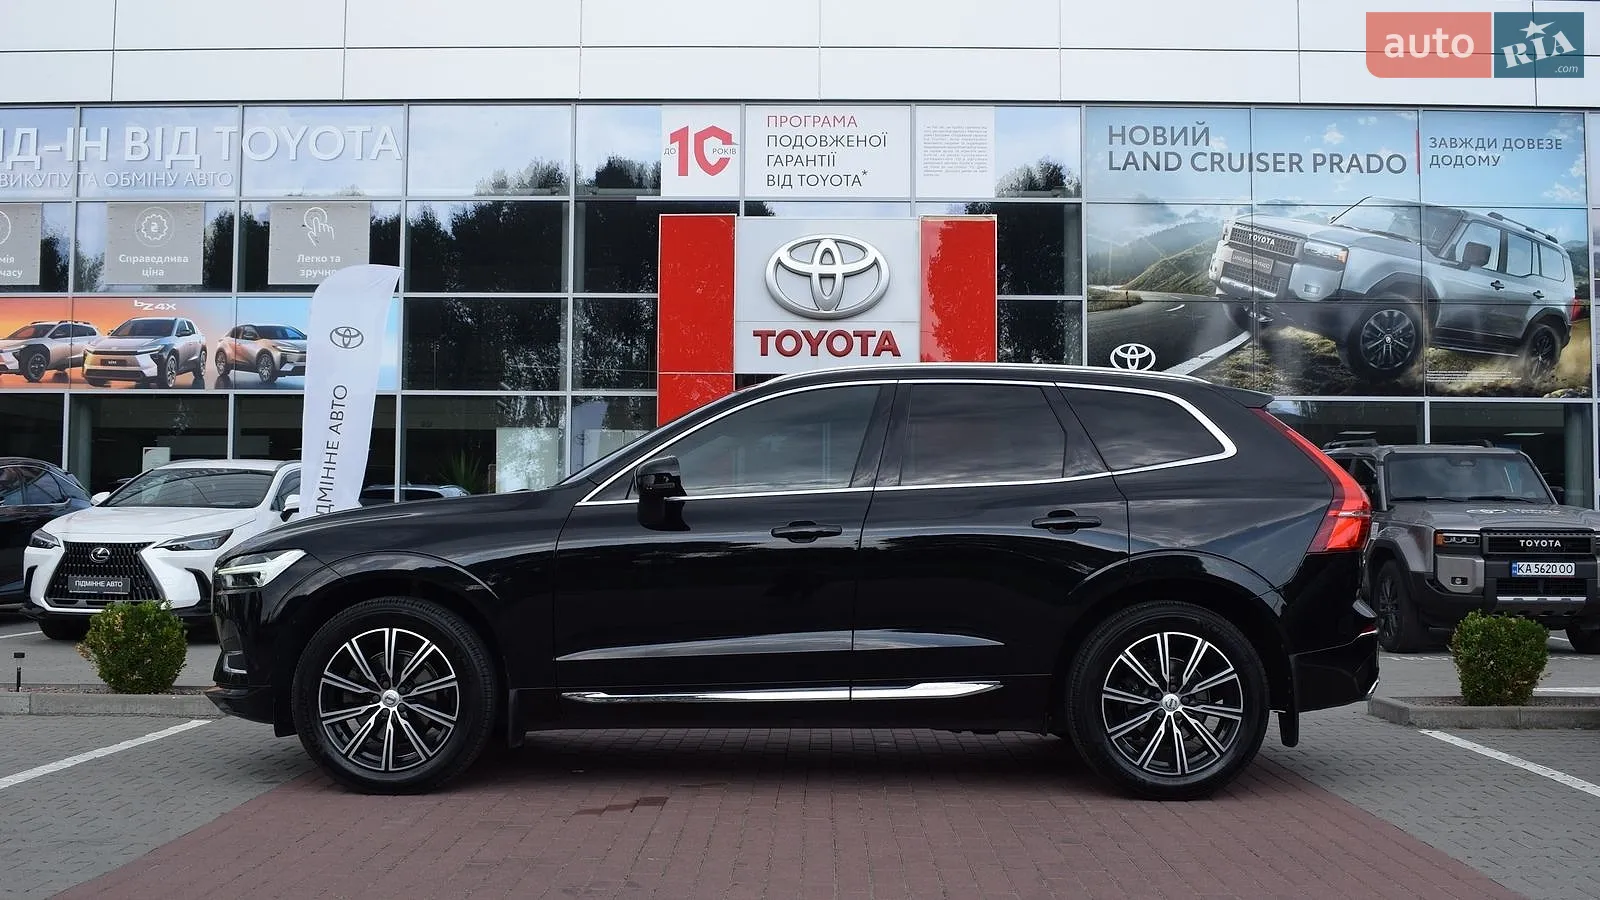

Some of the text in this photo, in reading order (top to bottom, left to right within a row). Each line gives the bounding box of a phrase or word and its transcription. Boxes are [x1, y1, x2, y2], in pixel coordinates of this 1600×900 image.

[767, 115, 858, 128] ПРОГРАМА
[767, 131, 888, 150] ПОДОВЖЕНОЇ
[1108, 121, 1210, 147] НОВИЙ
[0, 126, 403, 170] Д-ІН ВІД TOYOTA
[664, 148, 676, 156] ДО
[712, 147, 737, 155] РОКІВ
[1429, 137, 1563, 152] ЗАВЖДИ ДОВЕЗЕ
[767, 151, 837, 167] ГАРАНТІЇ
[1108, 151, 1407, 174] LAND CRUISER PRADO
[1429, 154, 1501, 168] ДОДОМУ
[0, 171, 234, 188] ВИКУПУ ТА ОБМІНУ АВТО
[767, 175, 792, 189] ВІД
[1248, 233, 1275, 246] TOYOTA
[119, 253, 189, 266] Справедлива
[297, 254, 341, 264] Легко та
[142, 267, 165, 278] ціна
[753, 329, 901, 358] TOYOTA
[329, 385, 348, 435] АВТО
[1517, 564, 1532, 574] KA
[1534, 564, 1557, 574] 5620
